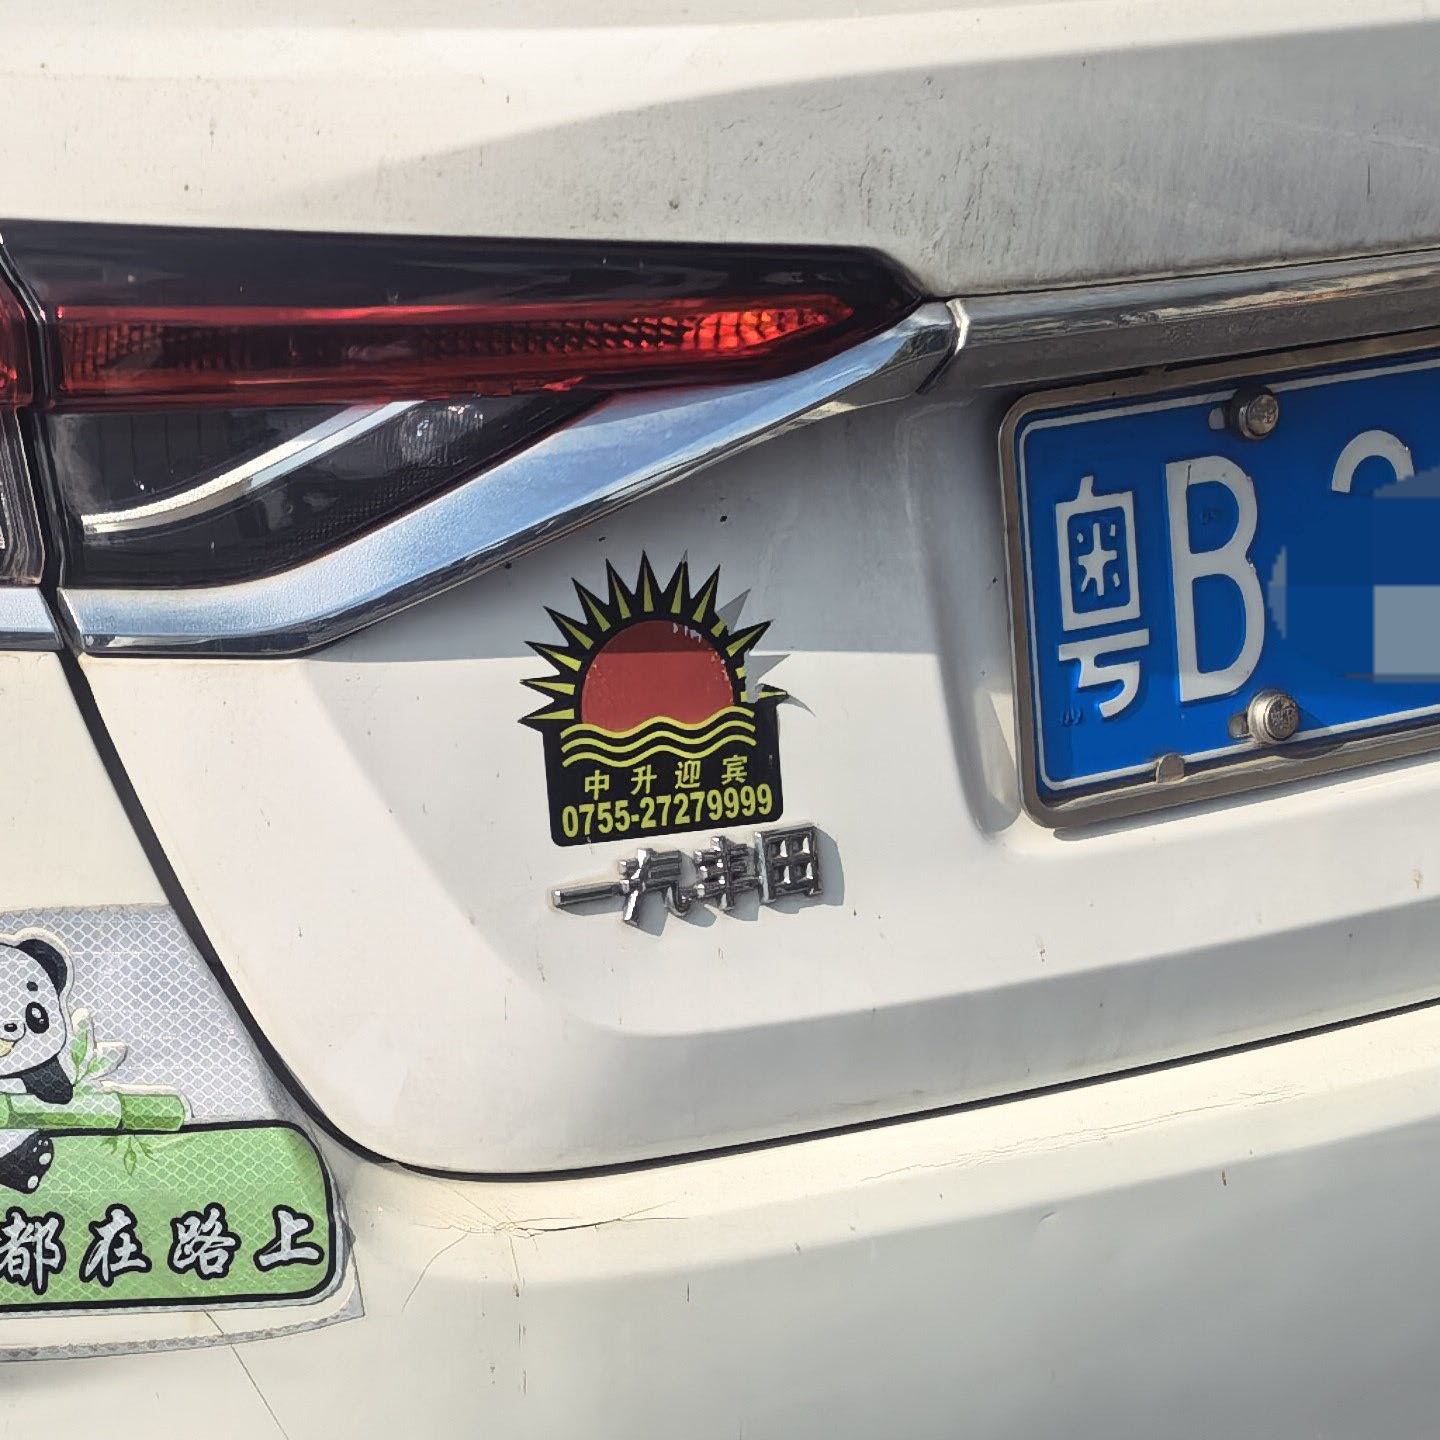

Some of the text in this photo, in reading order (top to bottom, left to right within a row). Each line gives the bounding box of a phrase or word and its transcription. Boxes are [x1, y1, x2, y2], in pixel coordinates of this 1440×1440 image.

[584, 755, 749, 801] 中升迎宾
[561, 783, 773, 838] 0755-27279999
